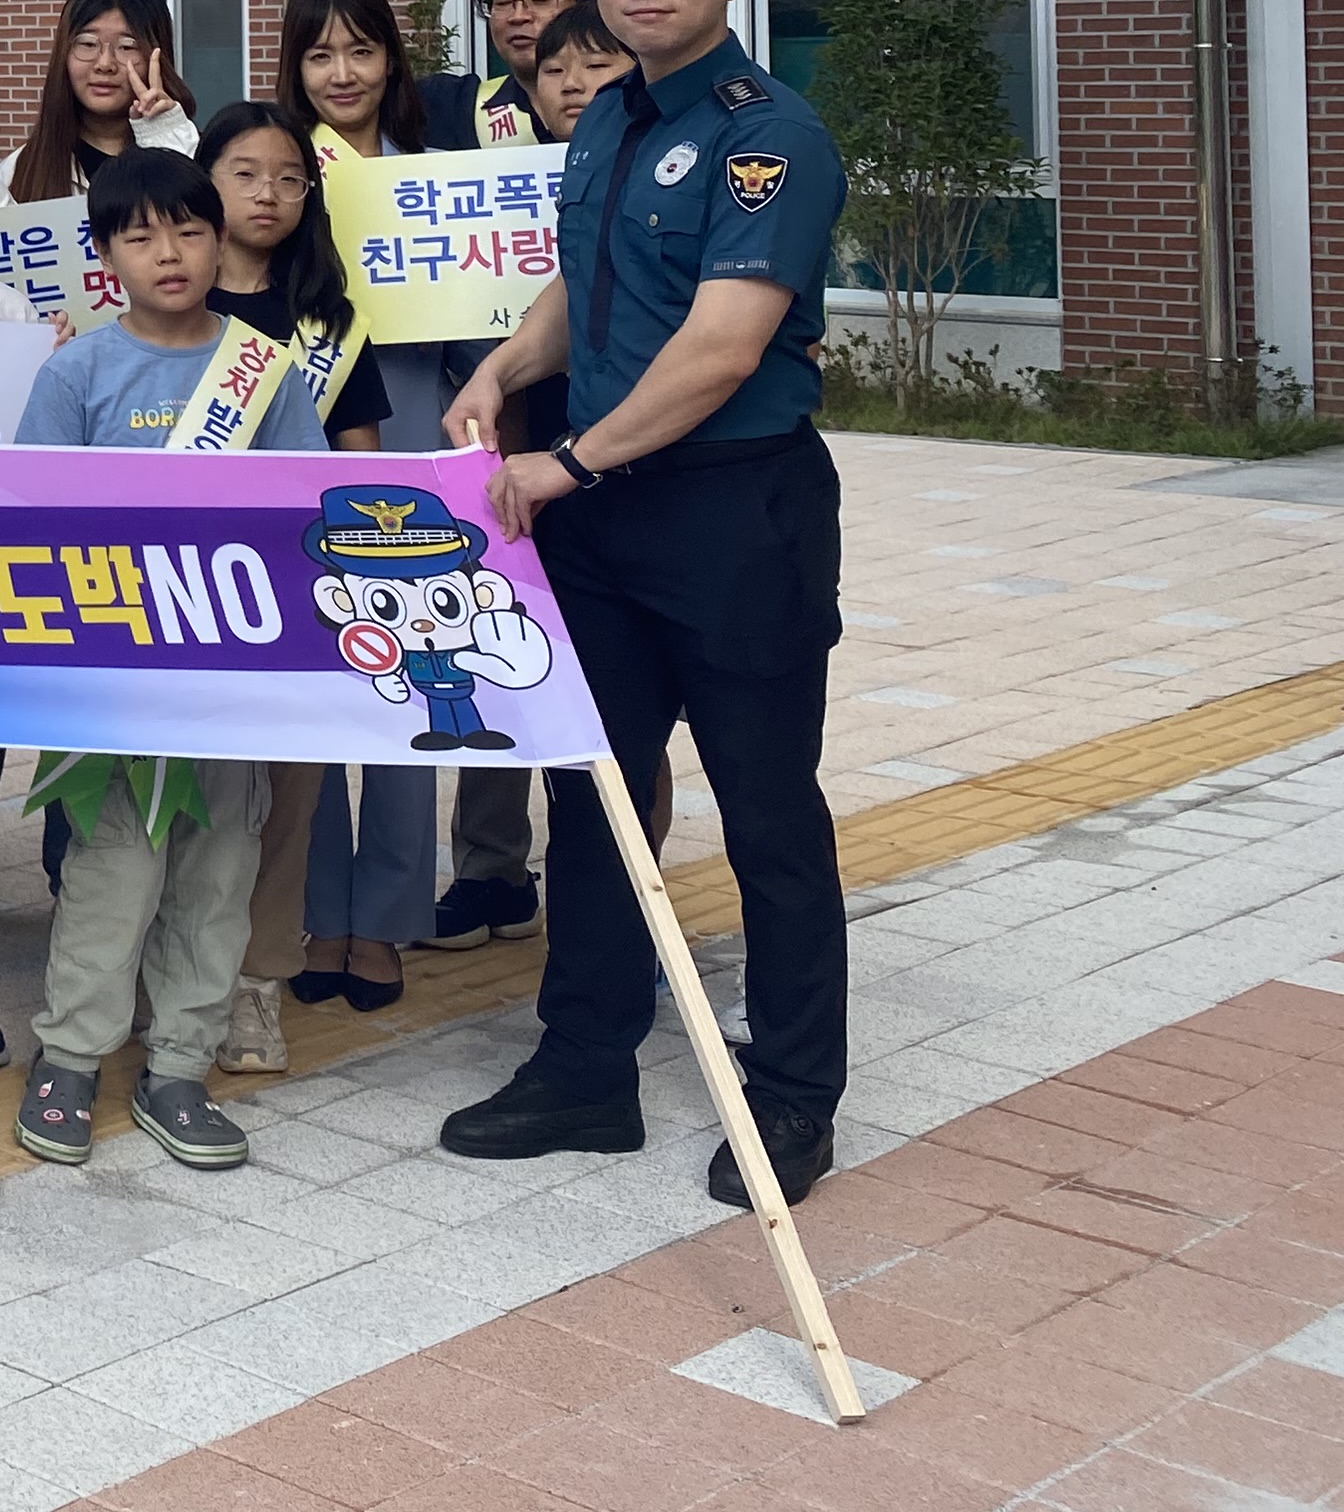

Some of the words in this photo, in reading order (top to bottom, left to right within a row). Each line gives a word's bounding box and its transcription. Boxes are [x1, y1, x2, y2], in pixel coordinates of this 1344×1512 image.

[740, 191, 766, 200] POLICE
[361, 227, 559, 285] 친구사랑
[129, 406, 184, 429] BOR
